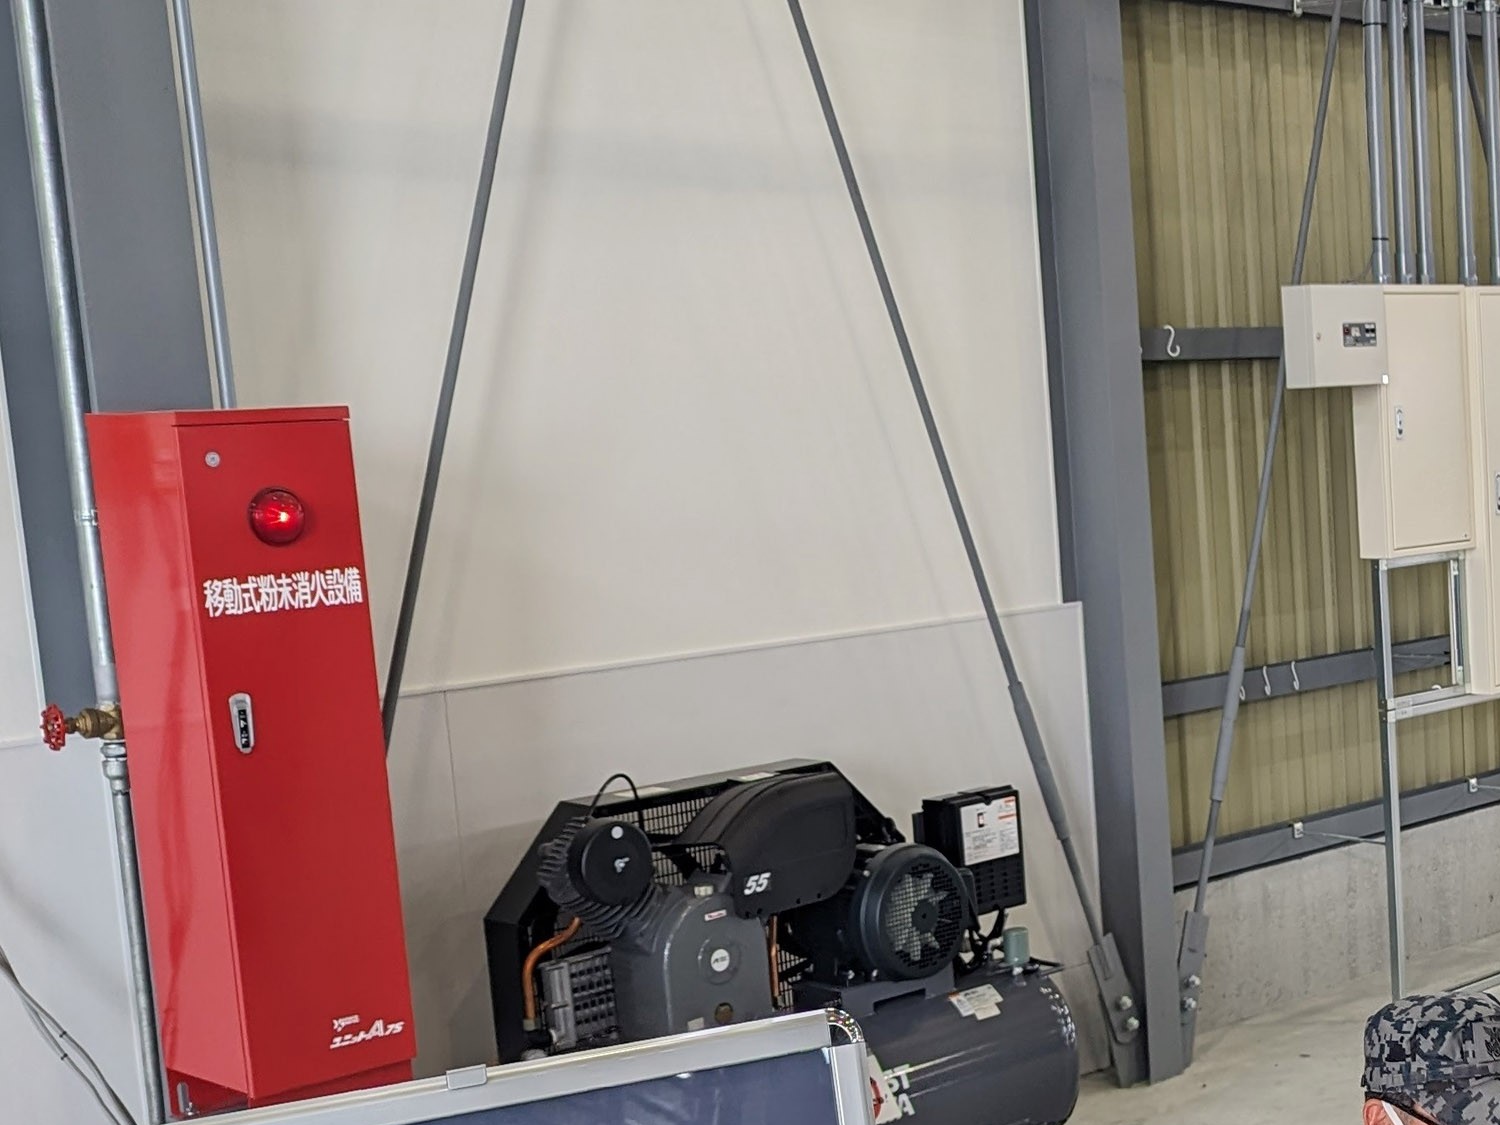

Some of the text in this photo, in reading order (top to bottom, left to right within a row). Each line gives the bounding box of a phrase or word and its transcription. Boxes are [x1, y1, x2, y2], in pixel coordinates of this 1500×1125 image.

[203, 567, 363, 619] 移動式粉末消火設備
[744, 872, 771, 895] 55
